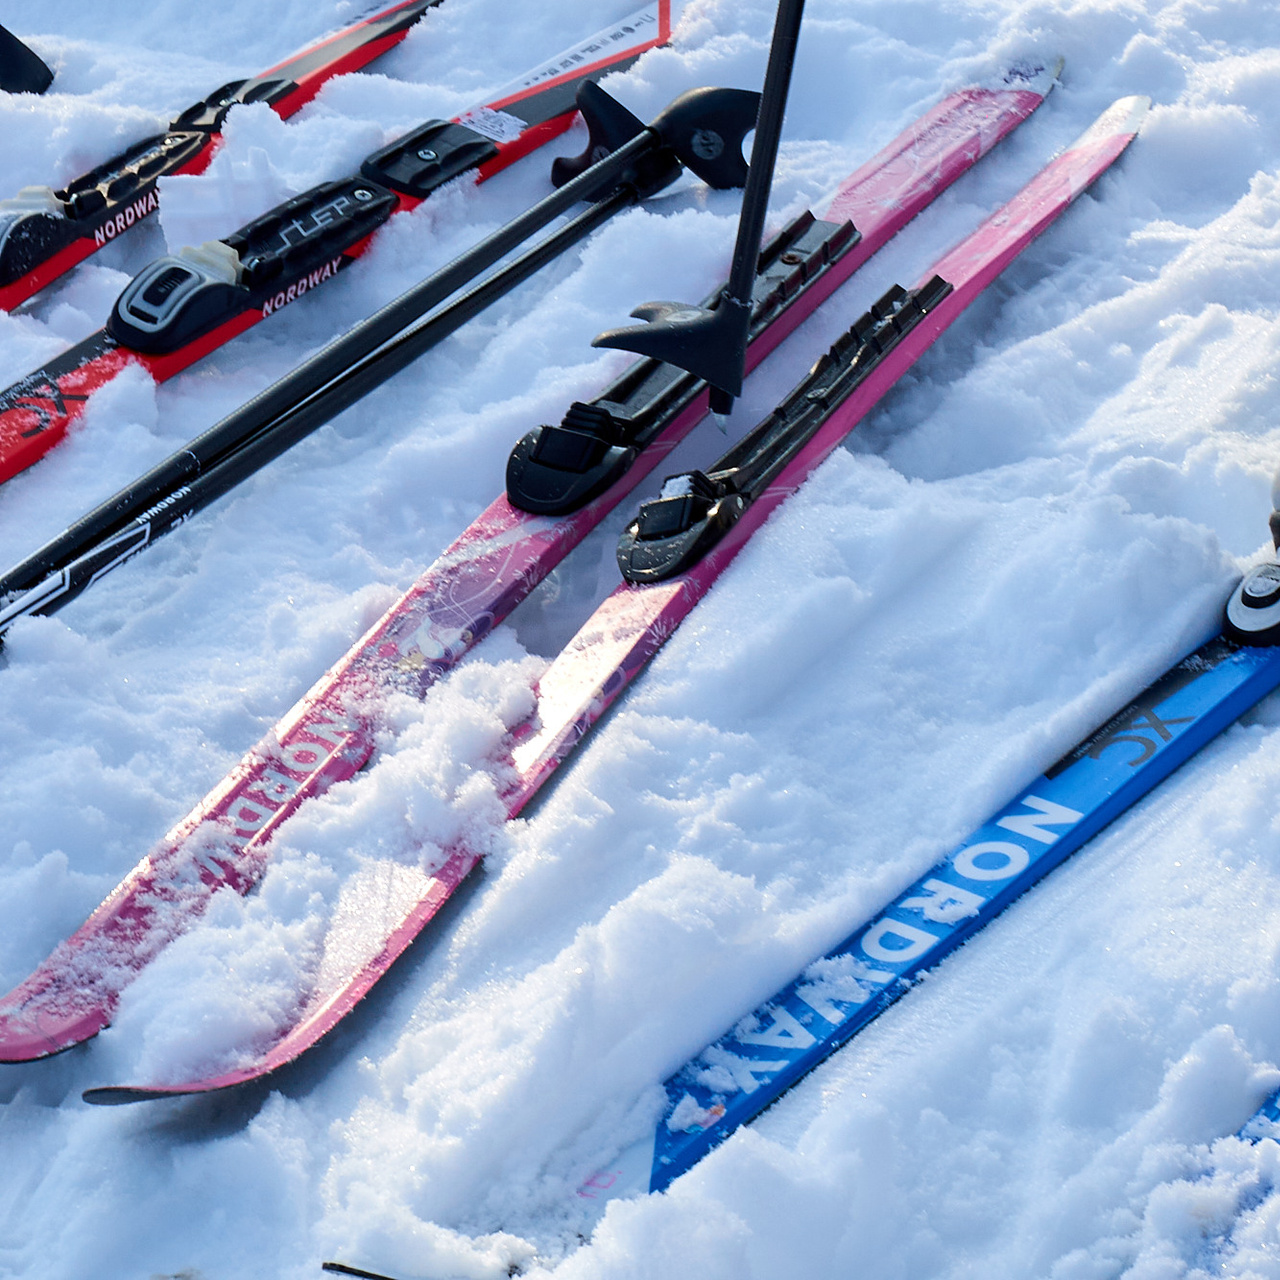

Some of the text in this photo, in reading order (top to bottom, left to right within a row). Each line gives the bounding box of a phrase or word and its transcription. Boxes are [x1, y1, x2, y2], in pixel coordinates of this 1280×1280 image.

[262, 256, 343, 319] NORDWAY
[134, 485, 192, 525] NORDWAY
[703, 795, 1084, 1095] NORDWAY
